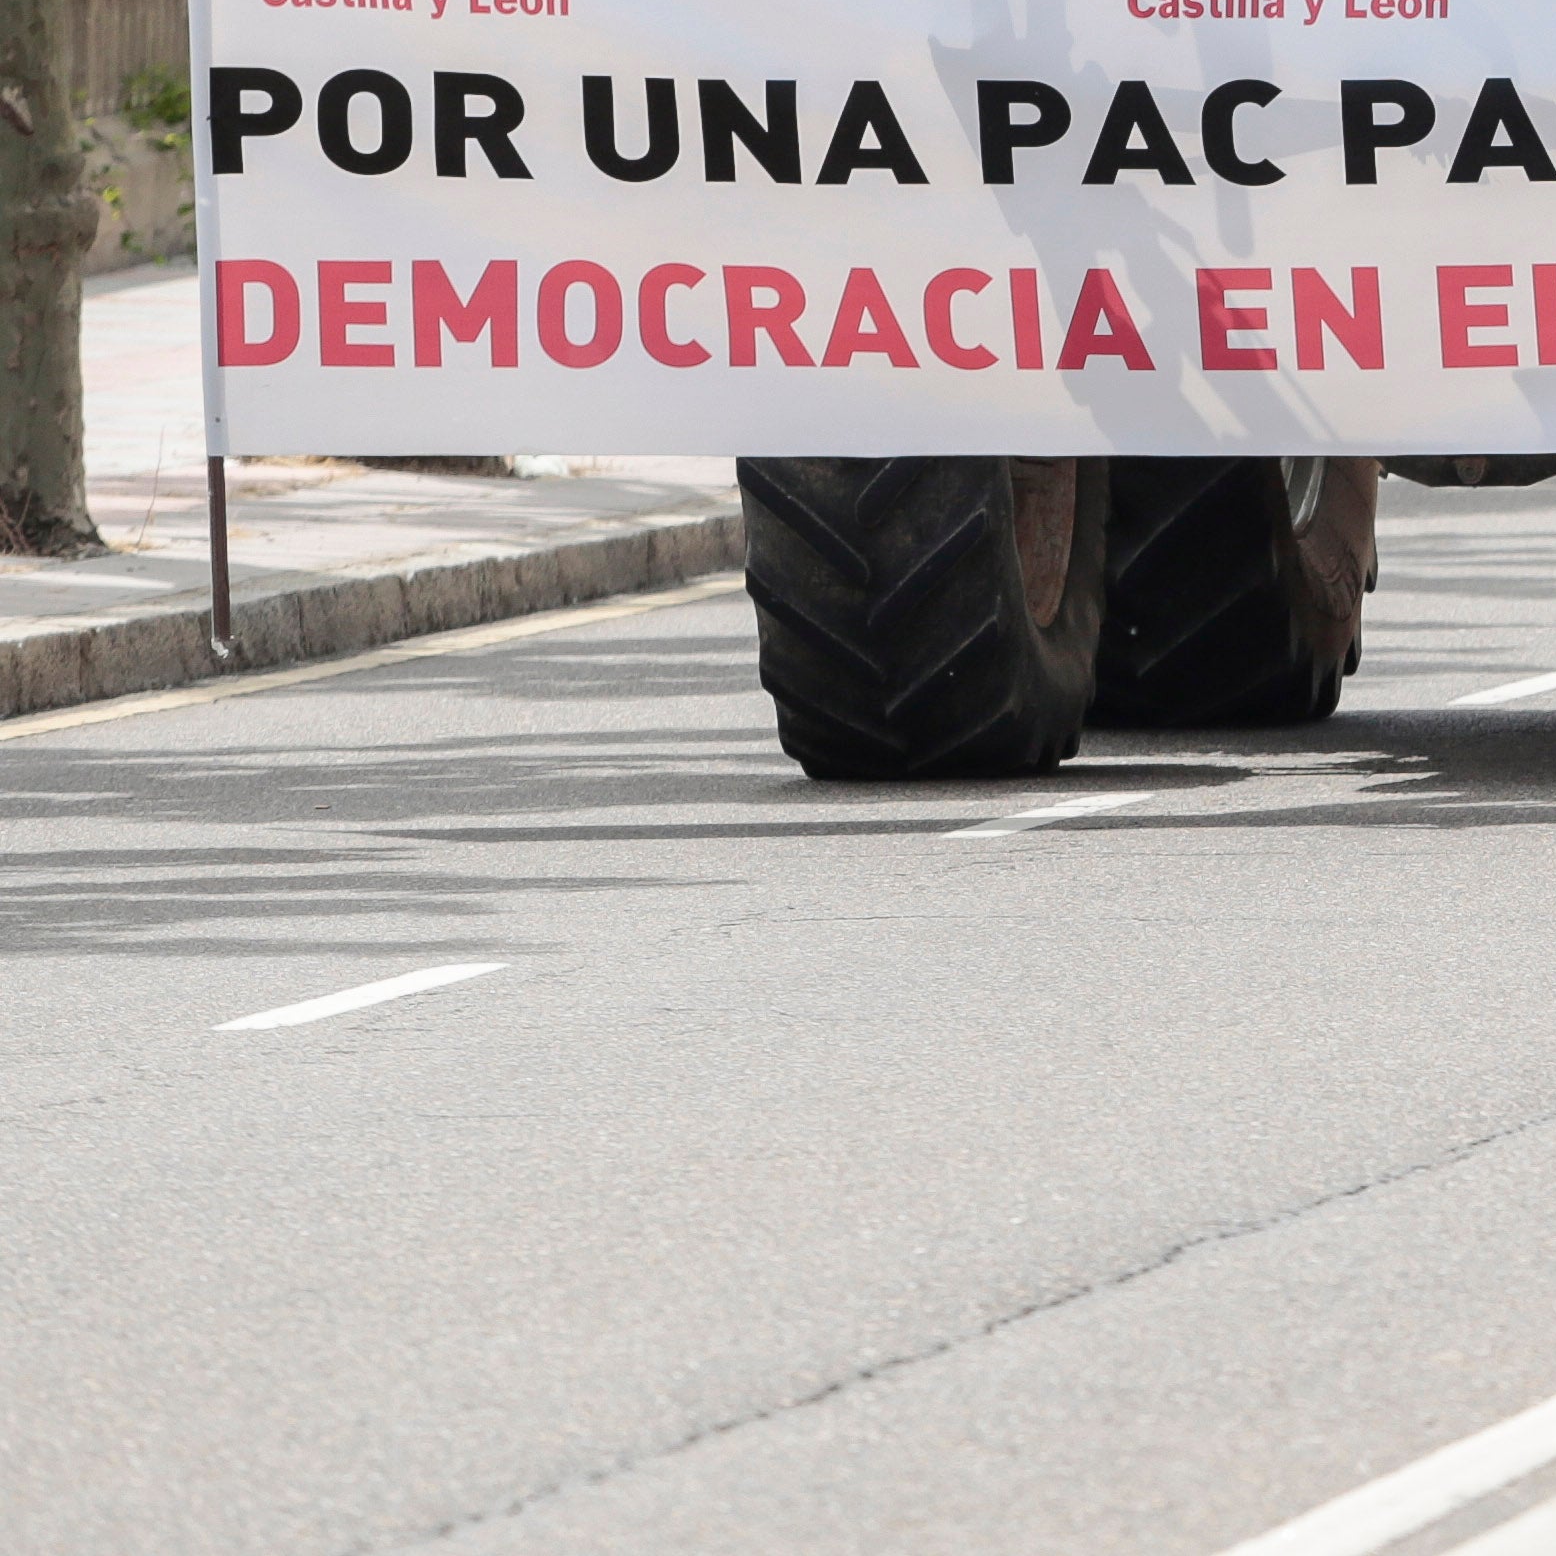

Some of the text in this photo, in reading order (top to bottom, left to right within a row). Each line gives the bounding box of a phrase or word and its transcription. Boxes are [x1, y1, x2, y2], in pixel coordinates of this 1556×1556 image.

[208, 67, 533, 180] POR
[582, 75, 930, 185] UNA
[976, 79, 1287, 186] PAC
[215, 259, 1155, 371] DEMOCRACIA
[1196, 266, 1385, 371] EN
